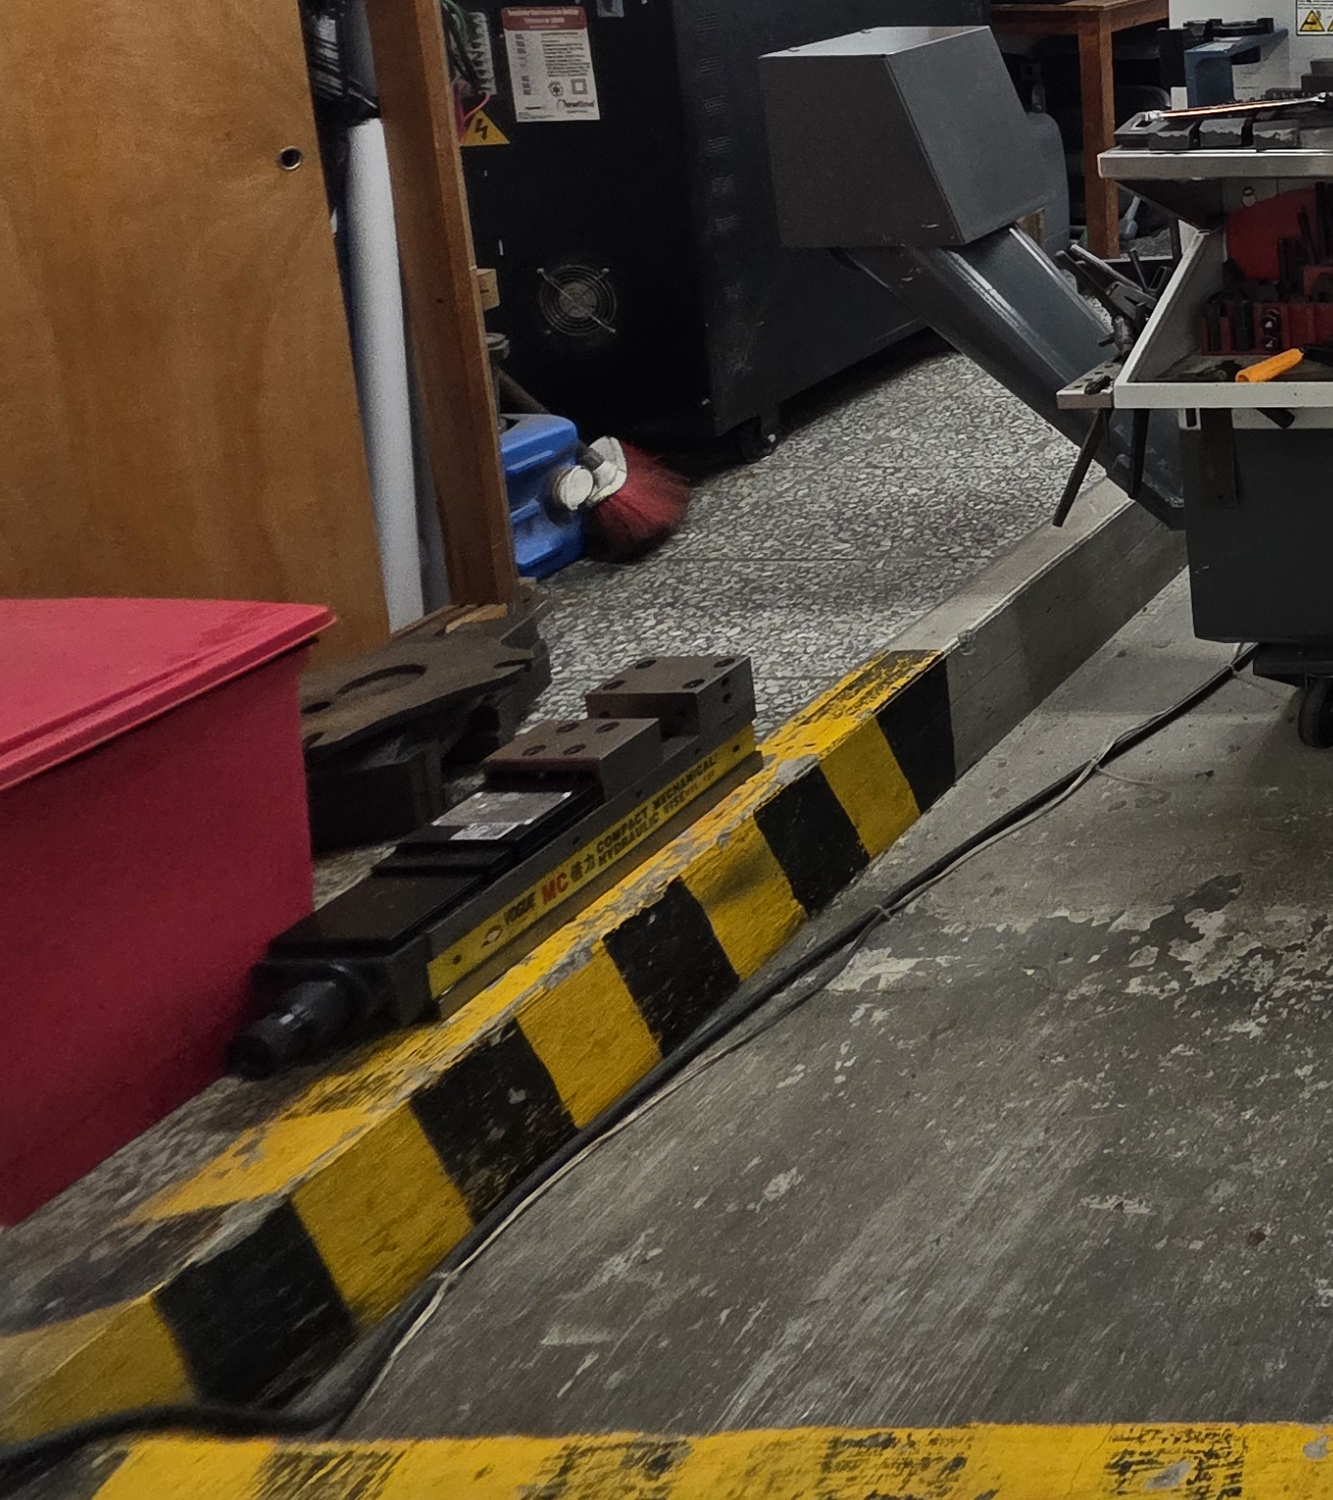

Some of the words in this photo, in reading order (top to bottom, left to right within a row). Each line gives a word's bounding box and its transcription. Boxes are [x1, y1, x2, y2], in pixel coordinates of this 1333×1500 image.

[596, 805, 649, 854] COMPACT
[652, 756, 718, 810] MECHANICAL
[598, 811, 660, 866] HYDRAULIC
[662, 790, 686, 814] VISE
[541, 871, 569, 905] MC
